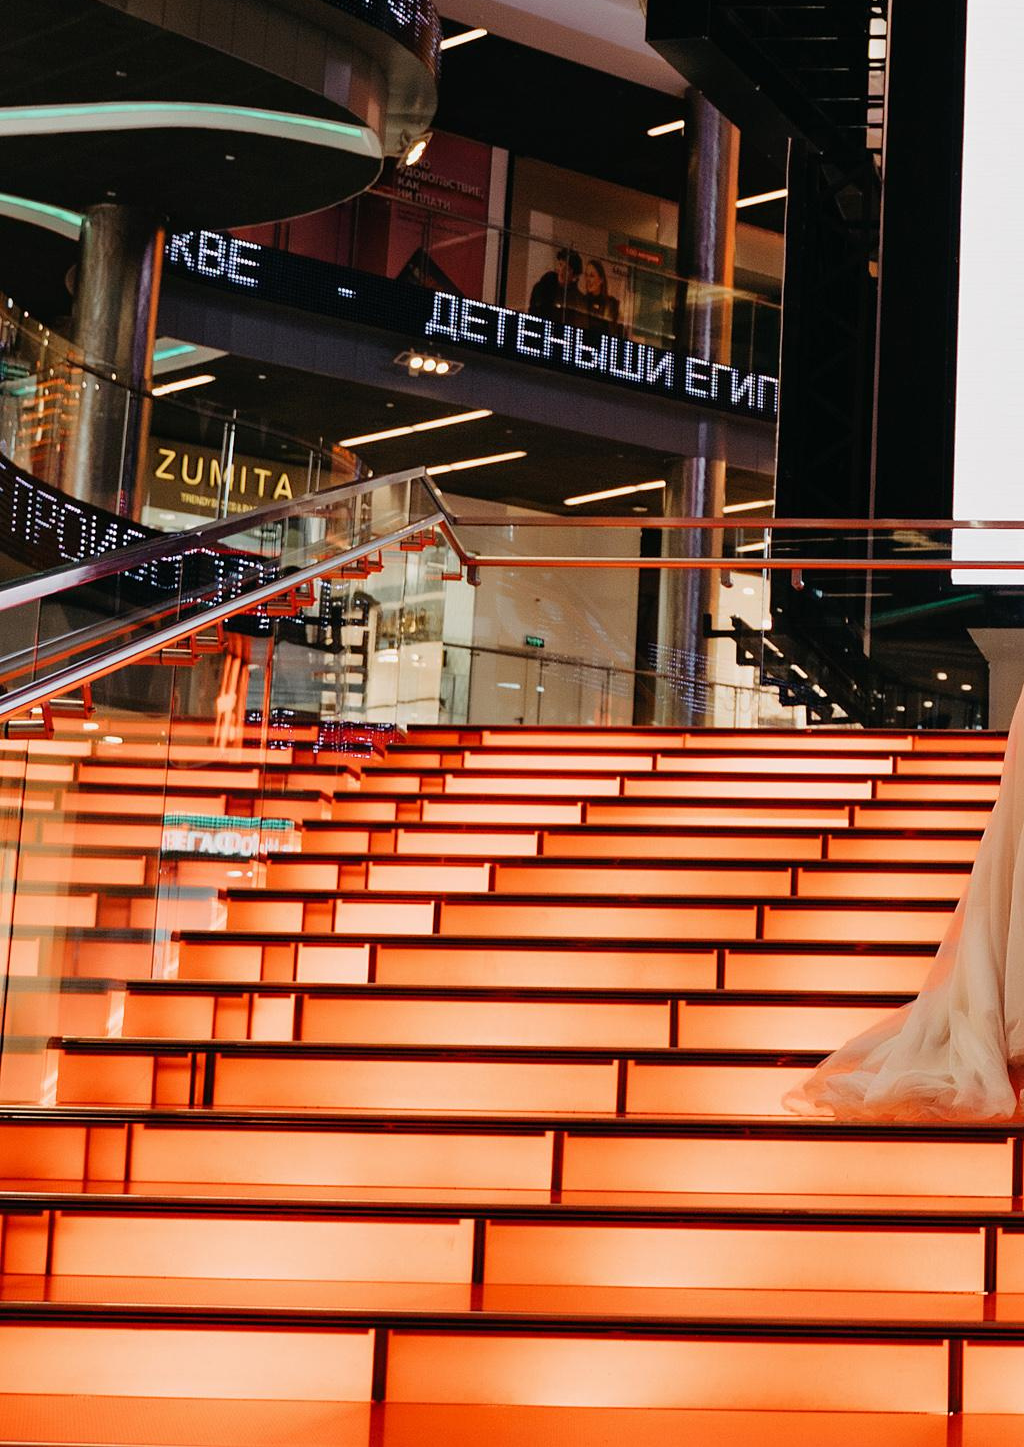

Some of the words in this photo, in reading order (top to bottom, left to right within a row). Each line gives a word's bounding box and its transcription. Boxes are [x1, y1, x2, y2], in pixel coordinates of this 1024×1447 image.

[165, 230, 262, 288] КВЕ
[425, 291, 674, 387] ДЕТЕНЫШИ
[685, 357, 779, 414] ЕГИП
[154, 448, 293, 500] ZUMITA
